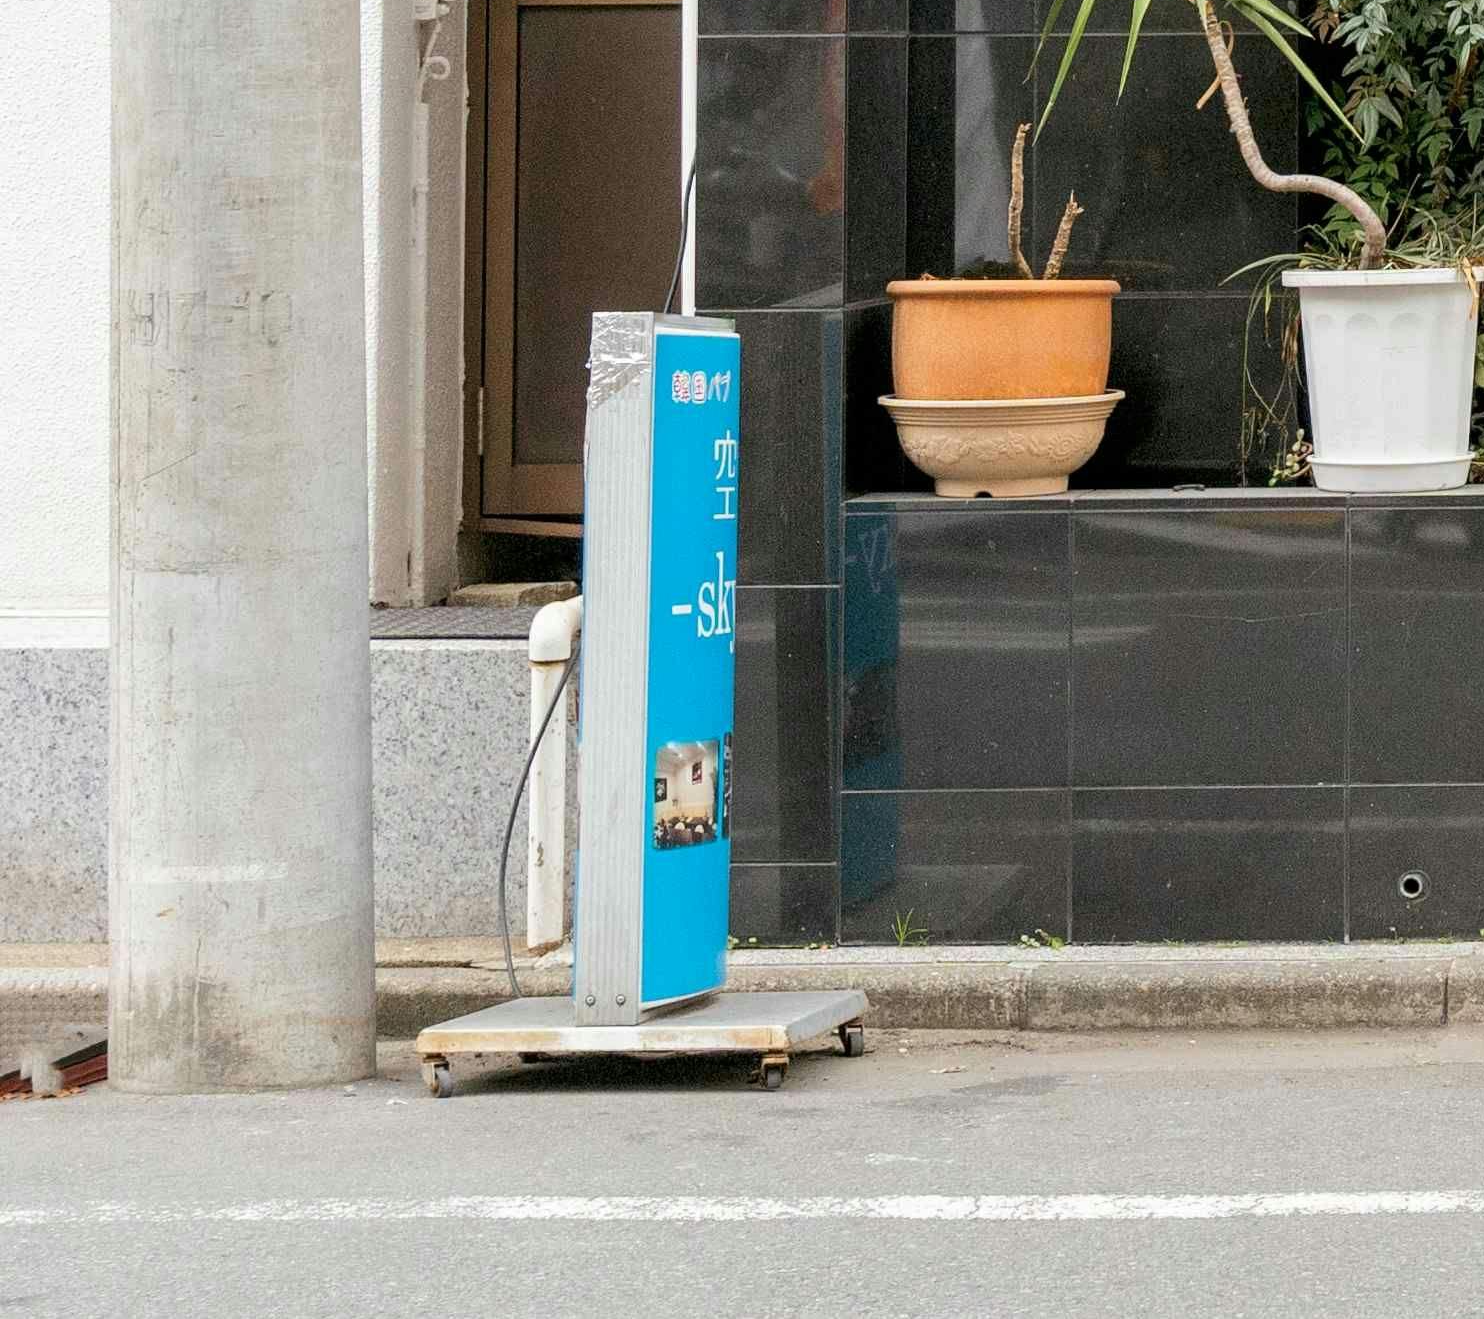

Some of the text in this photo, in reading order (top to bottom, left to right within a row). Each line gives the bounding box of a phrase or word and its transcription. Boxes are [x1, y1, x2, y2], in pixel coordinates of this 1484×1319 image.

[671, 368, 731, 405] 韓国パブ
[713, 429, 738, 521] 空
